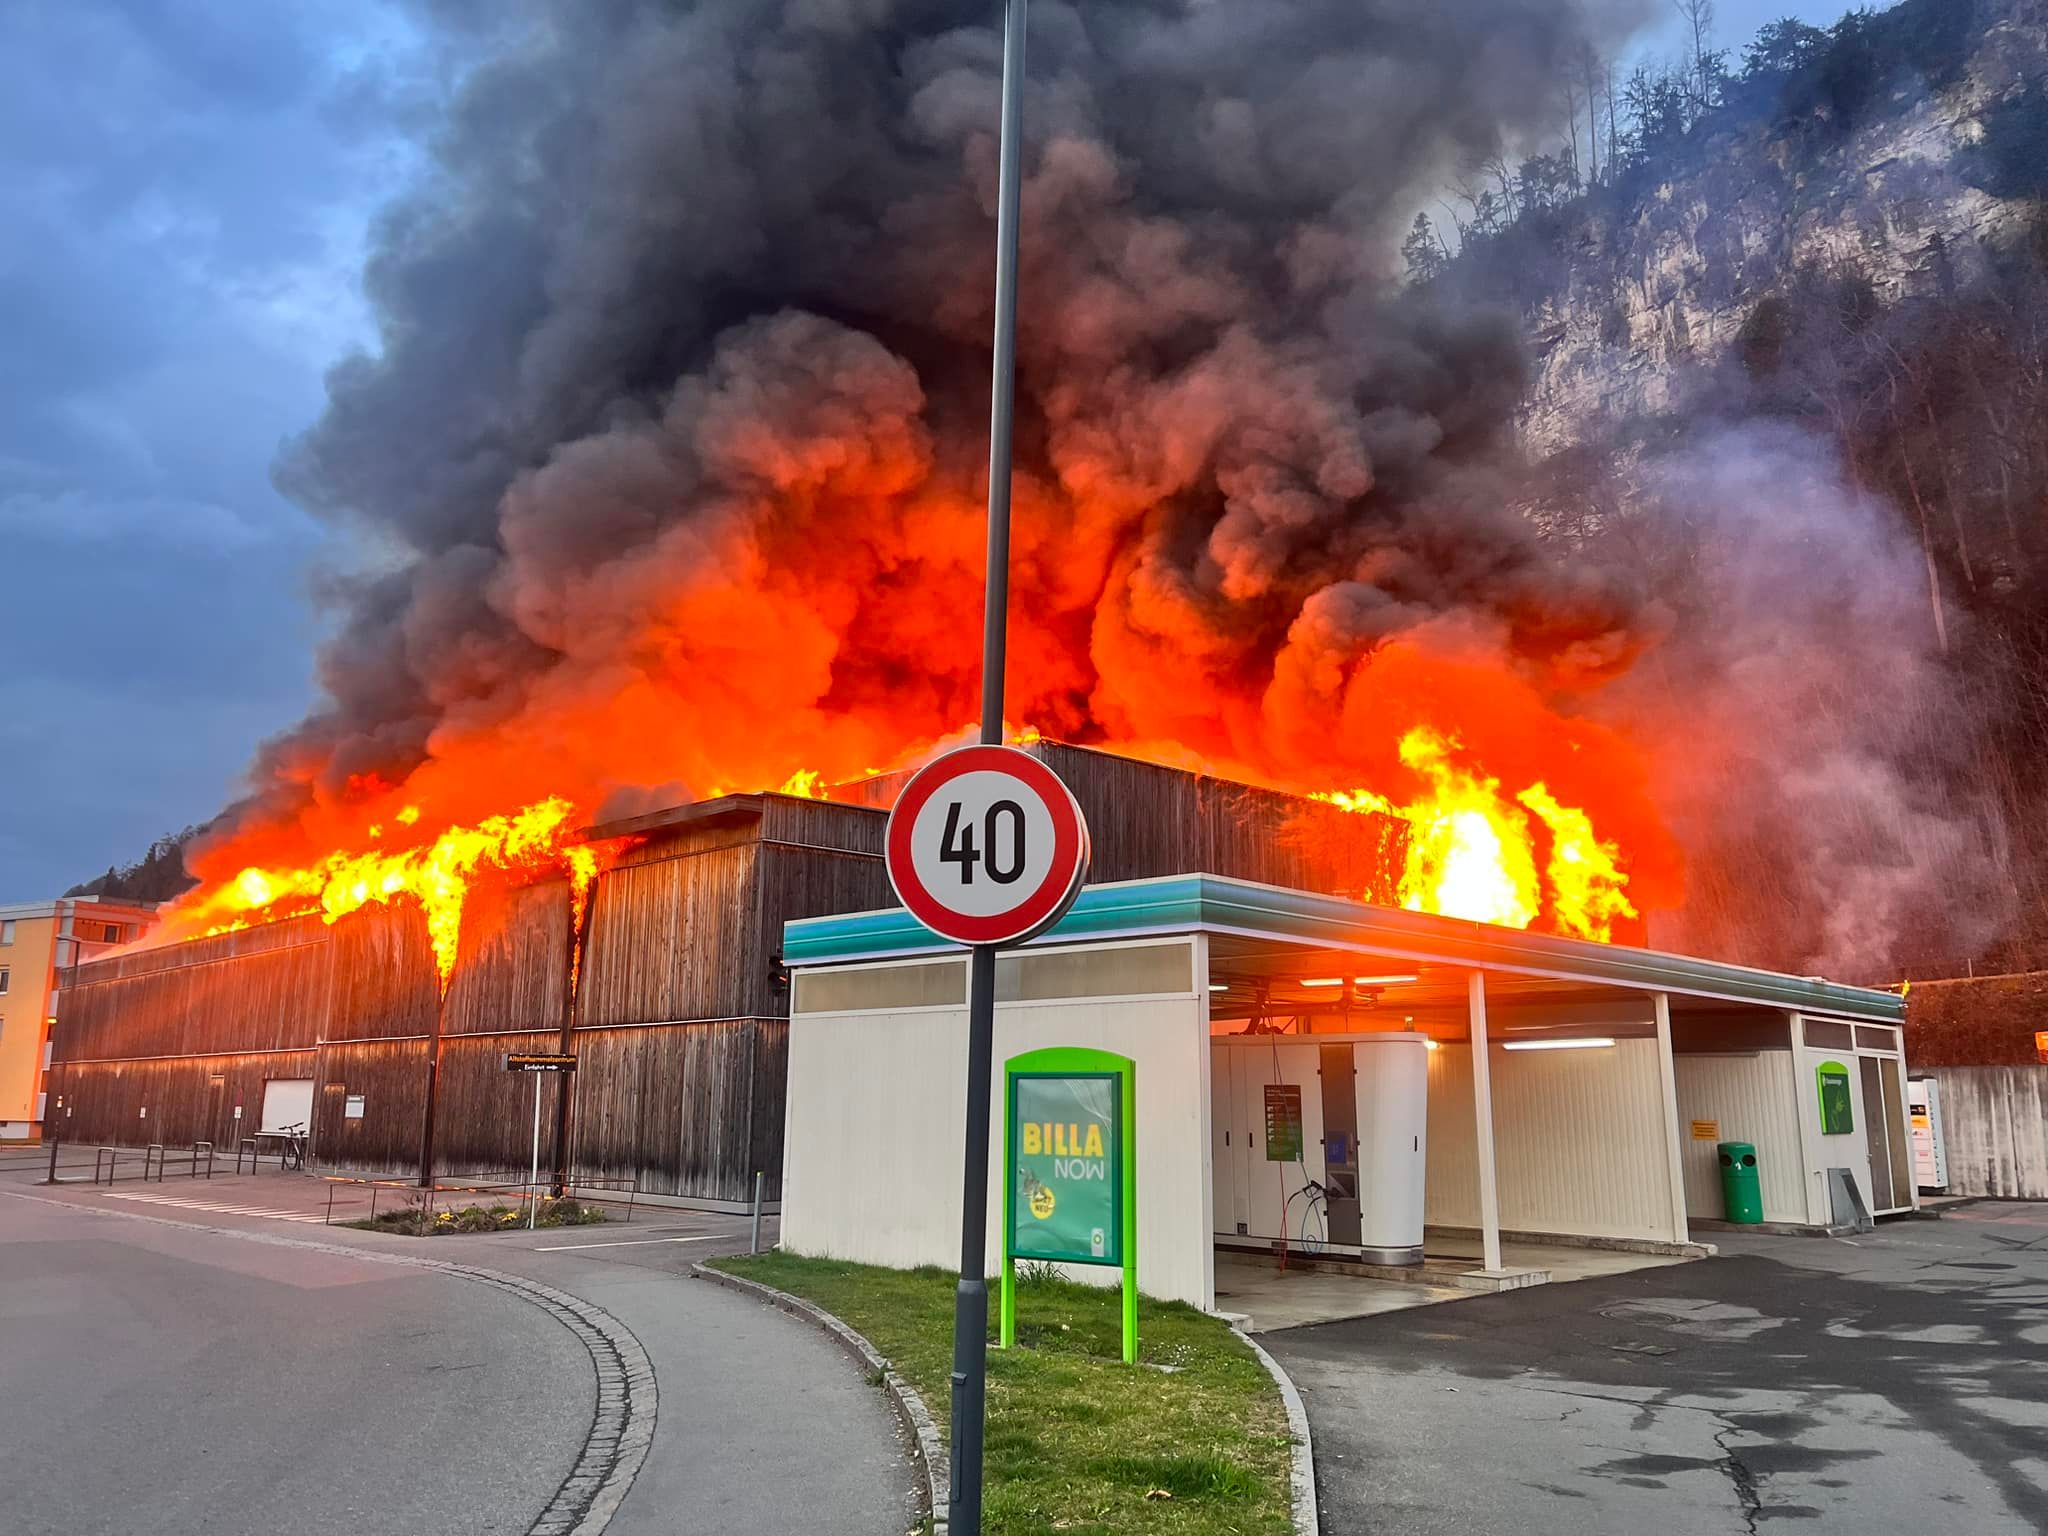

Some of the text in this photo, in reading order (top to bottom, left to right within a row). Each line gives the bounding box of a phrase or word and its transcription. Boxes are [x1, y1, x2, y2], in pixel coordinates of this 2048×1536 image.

[940, 800, 1026, 885] 40
[1023, 1122, 1105, 1157] BILLA
[1055, 1158, 1104, 1180] NOW
